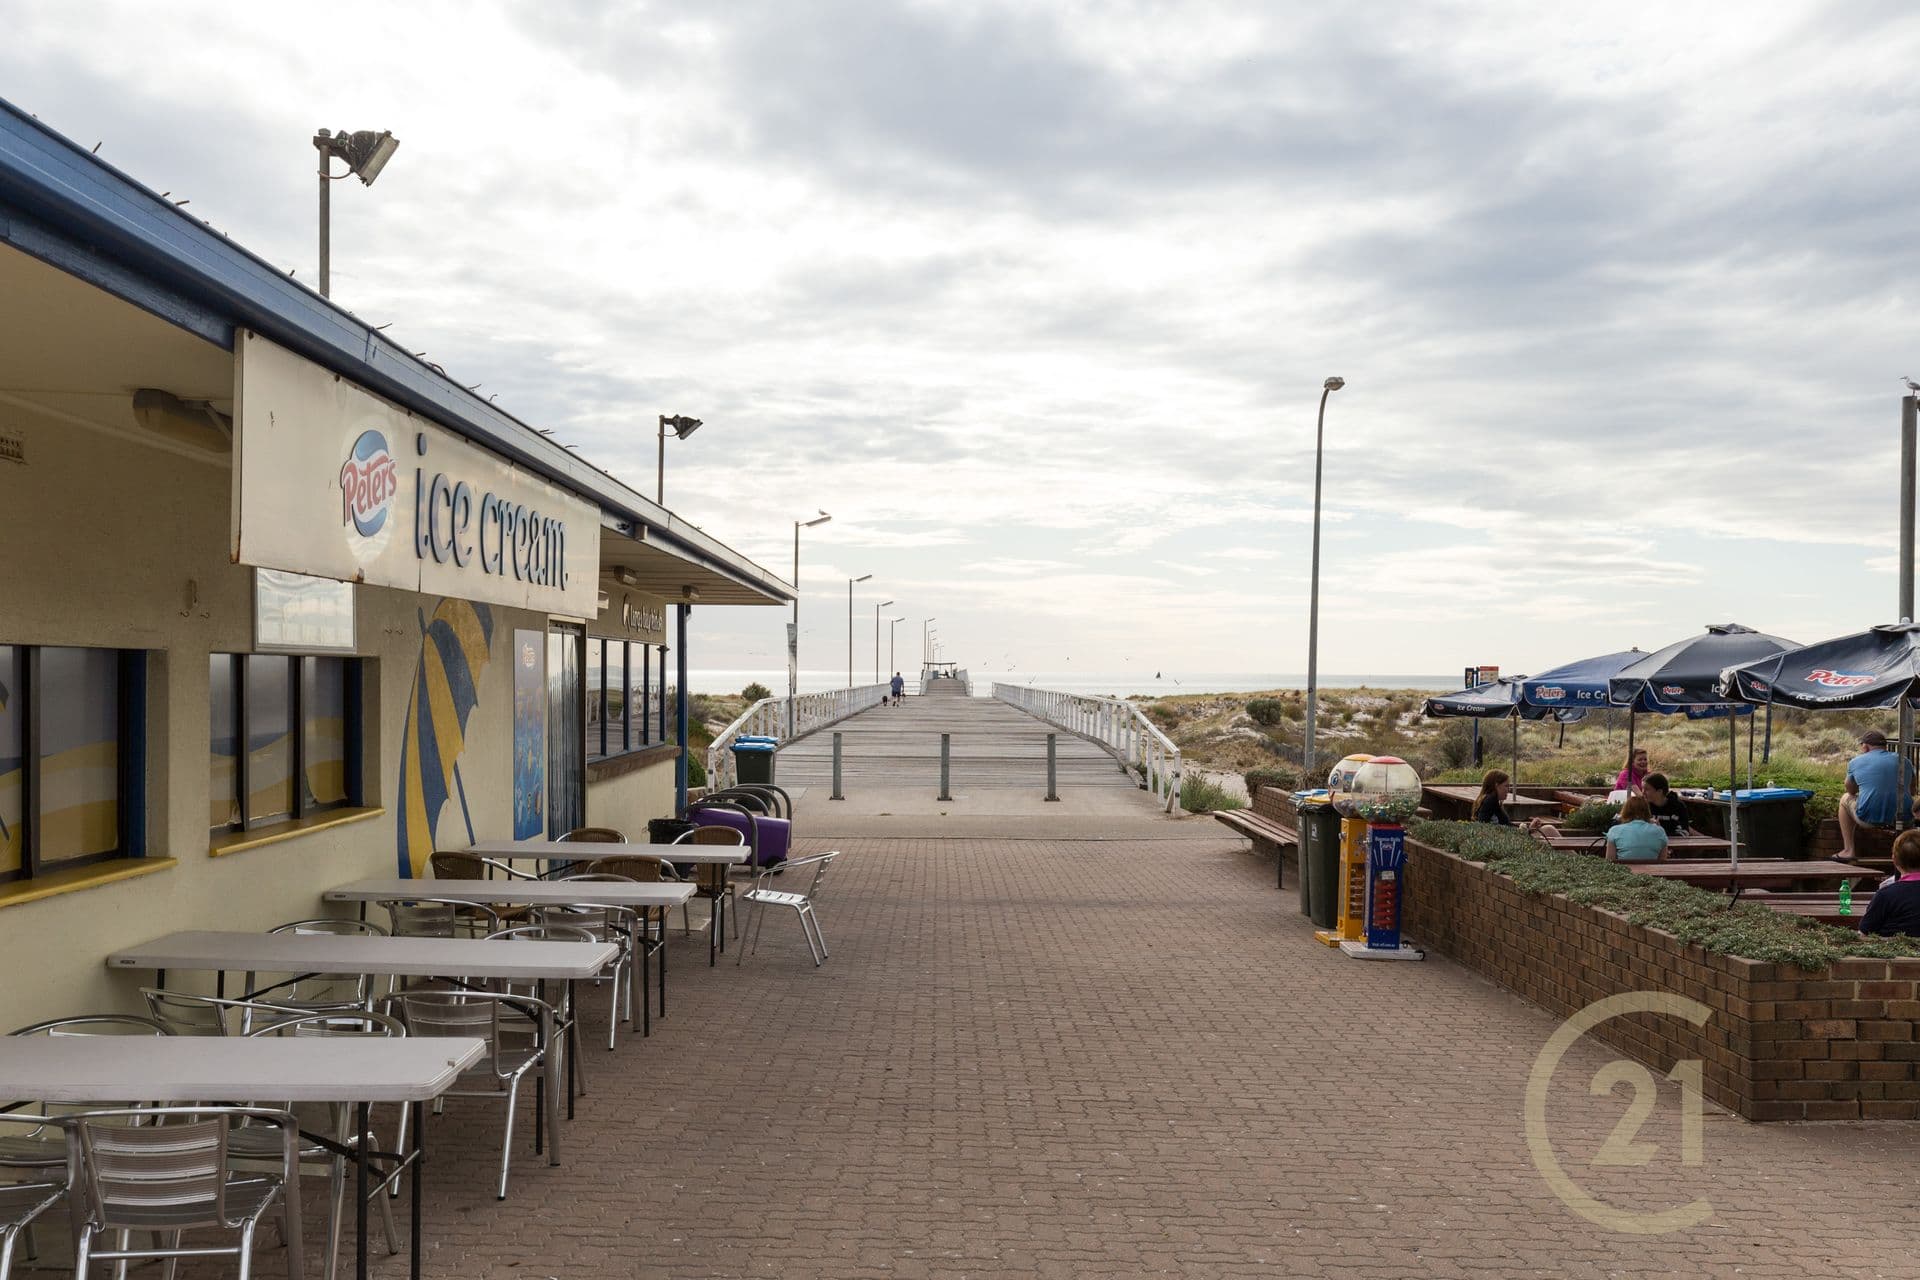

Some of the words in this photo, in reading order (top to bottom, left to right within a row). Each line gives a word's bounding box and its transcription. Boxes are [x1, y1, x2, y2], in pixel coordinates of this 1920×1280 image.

[416, 432, 473, 569] ice
[480, 491, 569, 592] cream
[1805, 669, 1875, 687] Peters
[1577, 689, 1592, 699] Ice
[1466, 705, 1486, 713] Cream
